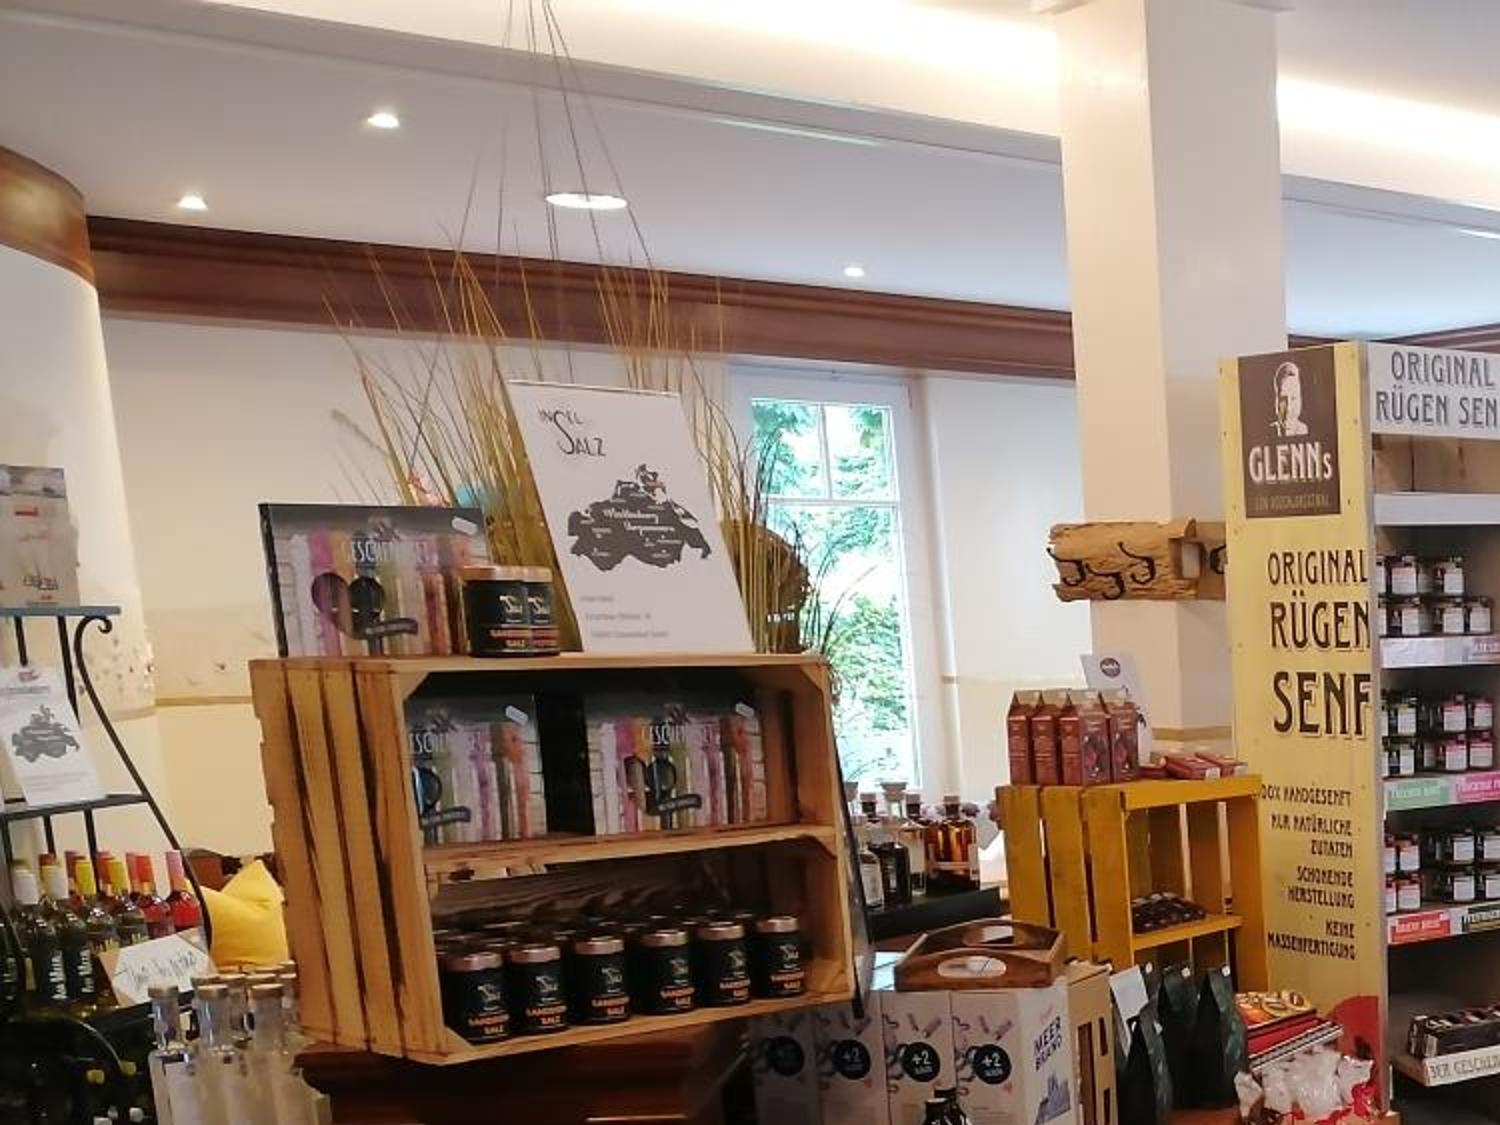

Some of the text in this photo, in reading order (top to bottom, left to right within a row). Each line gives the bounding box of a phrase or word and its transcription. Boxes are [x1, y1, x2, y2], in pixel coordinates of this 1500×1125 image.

[1391, 351, 1496, 387] ORIGINAL
[1376, 388, 1449, 426] RÜGEN
[1267, 550, 1369, 586] ORIGINAL
[1270, 589, 1372, 649] RÜGEN
[1272, 670, 1372, 736] SENF
[911, 1050, 931, 1066] +2
[981, 1052, 1002, 1068] +2
